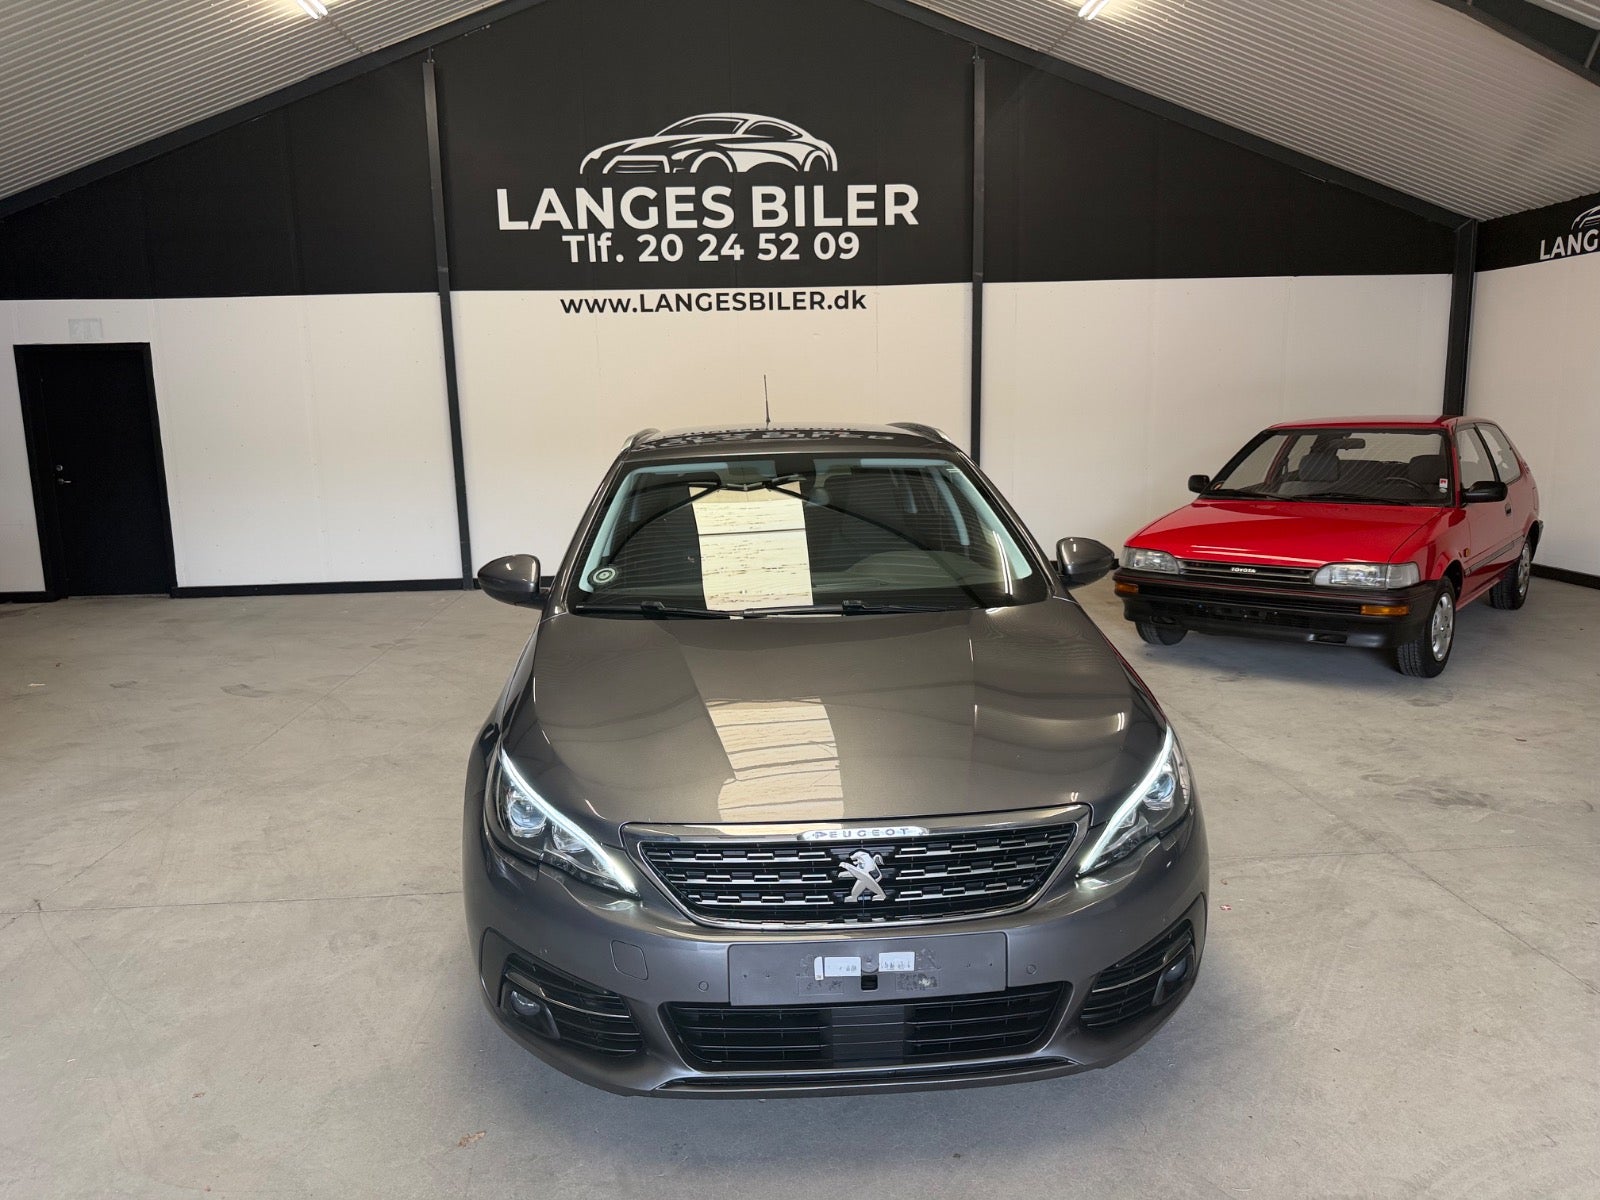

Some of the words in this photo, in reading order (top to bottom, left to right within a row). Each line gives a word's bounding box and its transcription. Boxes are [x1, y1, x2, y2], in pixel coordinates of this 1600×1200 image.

[496, 185, 735, 231] LANGES
[751, 183, 919, 228] BILER
[561, 231, 625, 263] Tlf.
[636, 233, 684, 263] 20
[696, 232, 745, 262] 24
[757, 232, 800, 261] 52
[813, 231, 860, 260] 09
[560, 289, 867, 314] www.LANGESBILER.dk
[1230, 566, 1257, 574] TOYOTA
[812, 827, 910, 839] PEUGEOT
